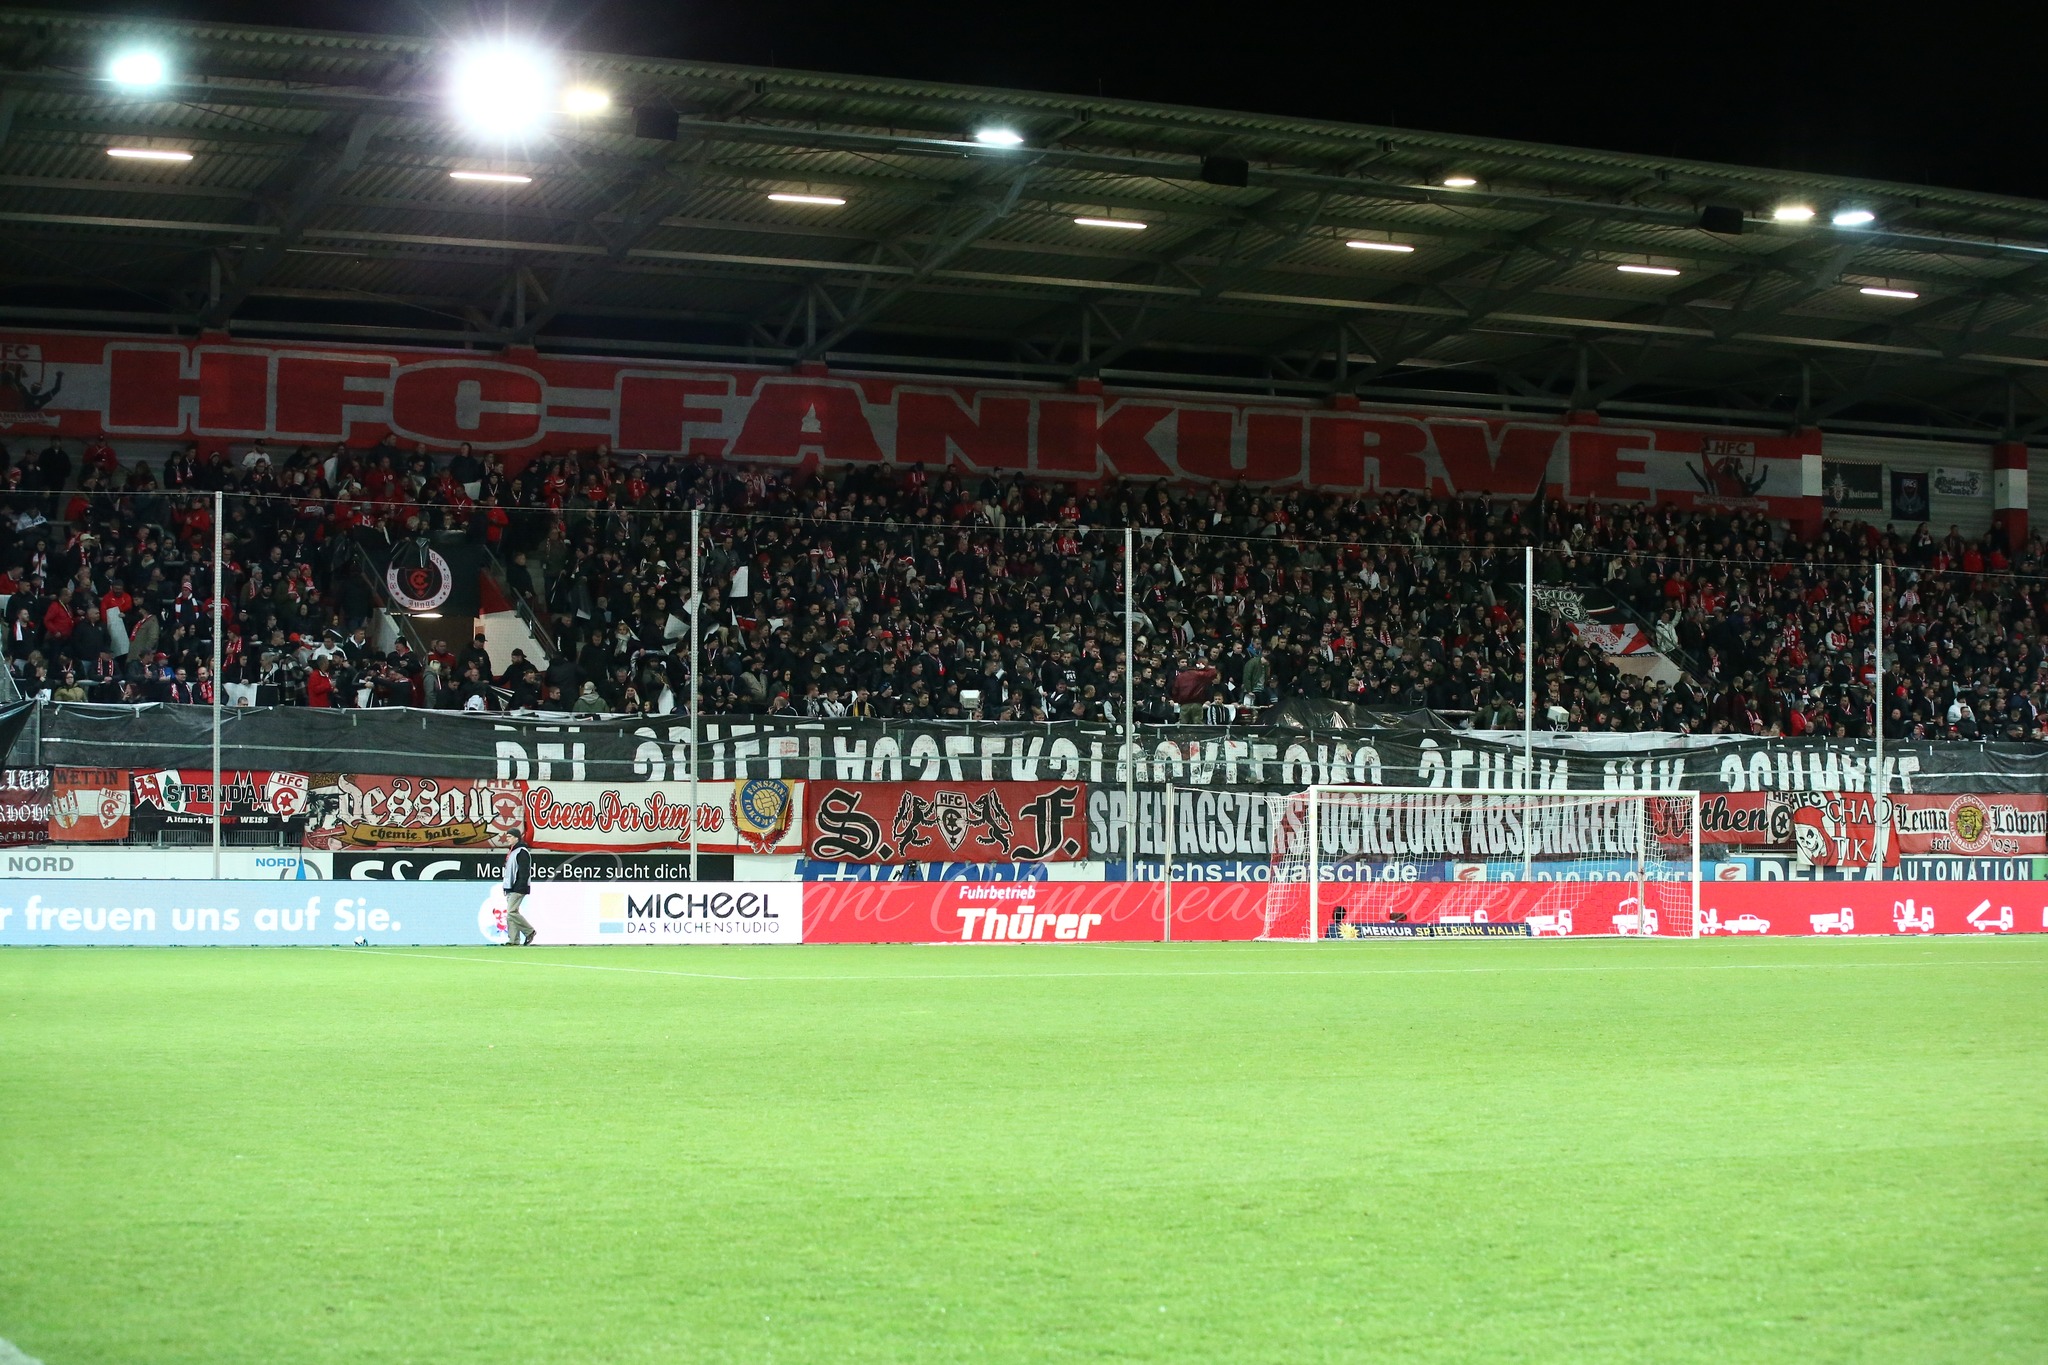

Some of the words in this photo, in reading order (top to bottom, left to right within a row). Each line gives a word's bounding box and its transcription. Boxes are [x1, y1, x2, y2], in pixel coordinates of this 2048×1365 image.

[0, 344, 29, 359] FC
[1714, 441, 1747, 454] HFC
[0, 769, 49, 791] LUB
[56, 770, 119, 785] WETTIN
[278, 774, 303, 788] HFC
[104, 789, 123, 800] HFC
[167, 784, 272, 803] STENDAL
[939, 794, 963, 806] HFC
[526, 786, 596, 830] Coesa
[597, 790, 642, 833] Per
[166, 816, 203, 824] Altmark
[240, 816, 269, 824] WEISS
[1894, 804, 1948, 833] Leuna
[1989, 804, 2046, 834] Löwen
[1930, 835, 1951, 851] seit
[8, 856, 74, 872] NORD
[255, 857, 297, 867] NORD
[476, 862, 601, 879] Merdes-Benz
[606, 862, 651, 879] sucht
[1893, 860, 2029, 881] AUTOMATION
[958, 885, 1036, 900] Fuhrbetrieb
[24, 895, 156, 932] freuen
[171, 907, 241, 932] uns
[253, 896, 321, 932] auf
[333, 897, 402, 932] Sie.
[627, 921, 657, 934] DAS
[956, 905, 1103, 940] Thürer
[1362, 926, 1413, 937] MERKUR
[1415, 926, 1483, 937] SPIELBANK
[1488, 925, 1527, 937] HALLE
